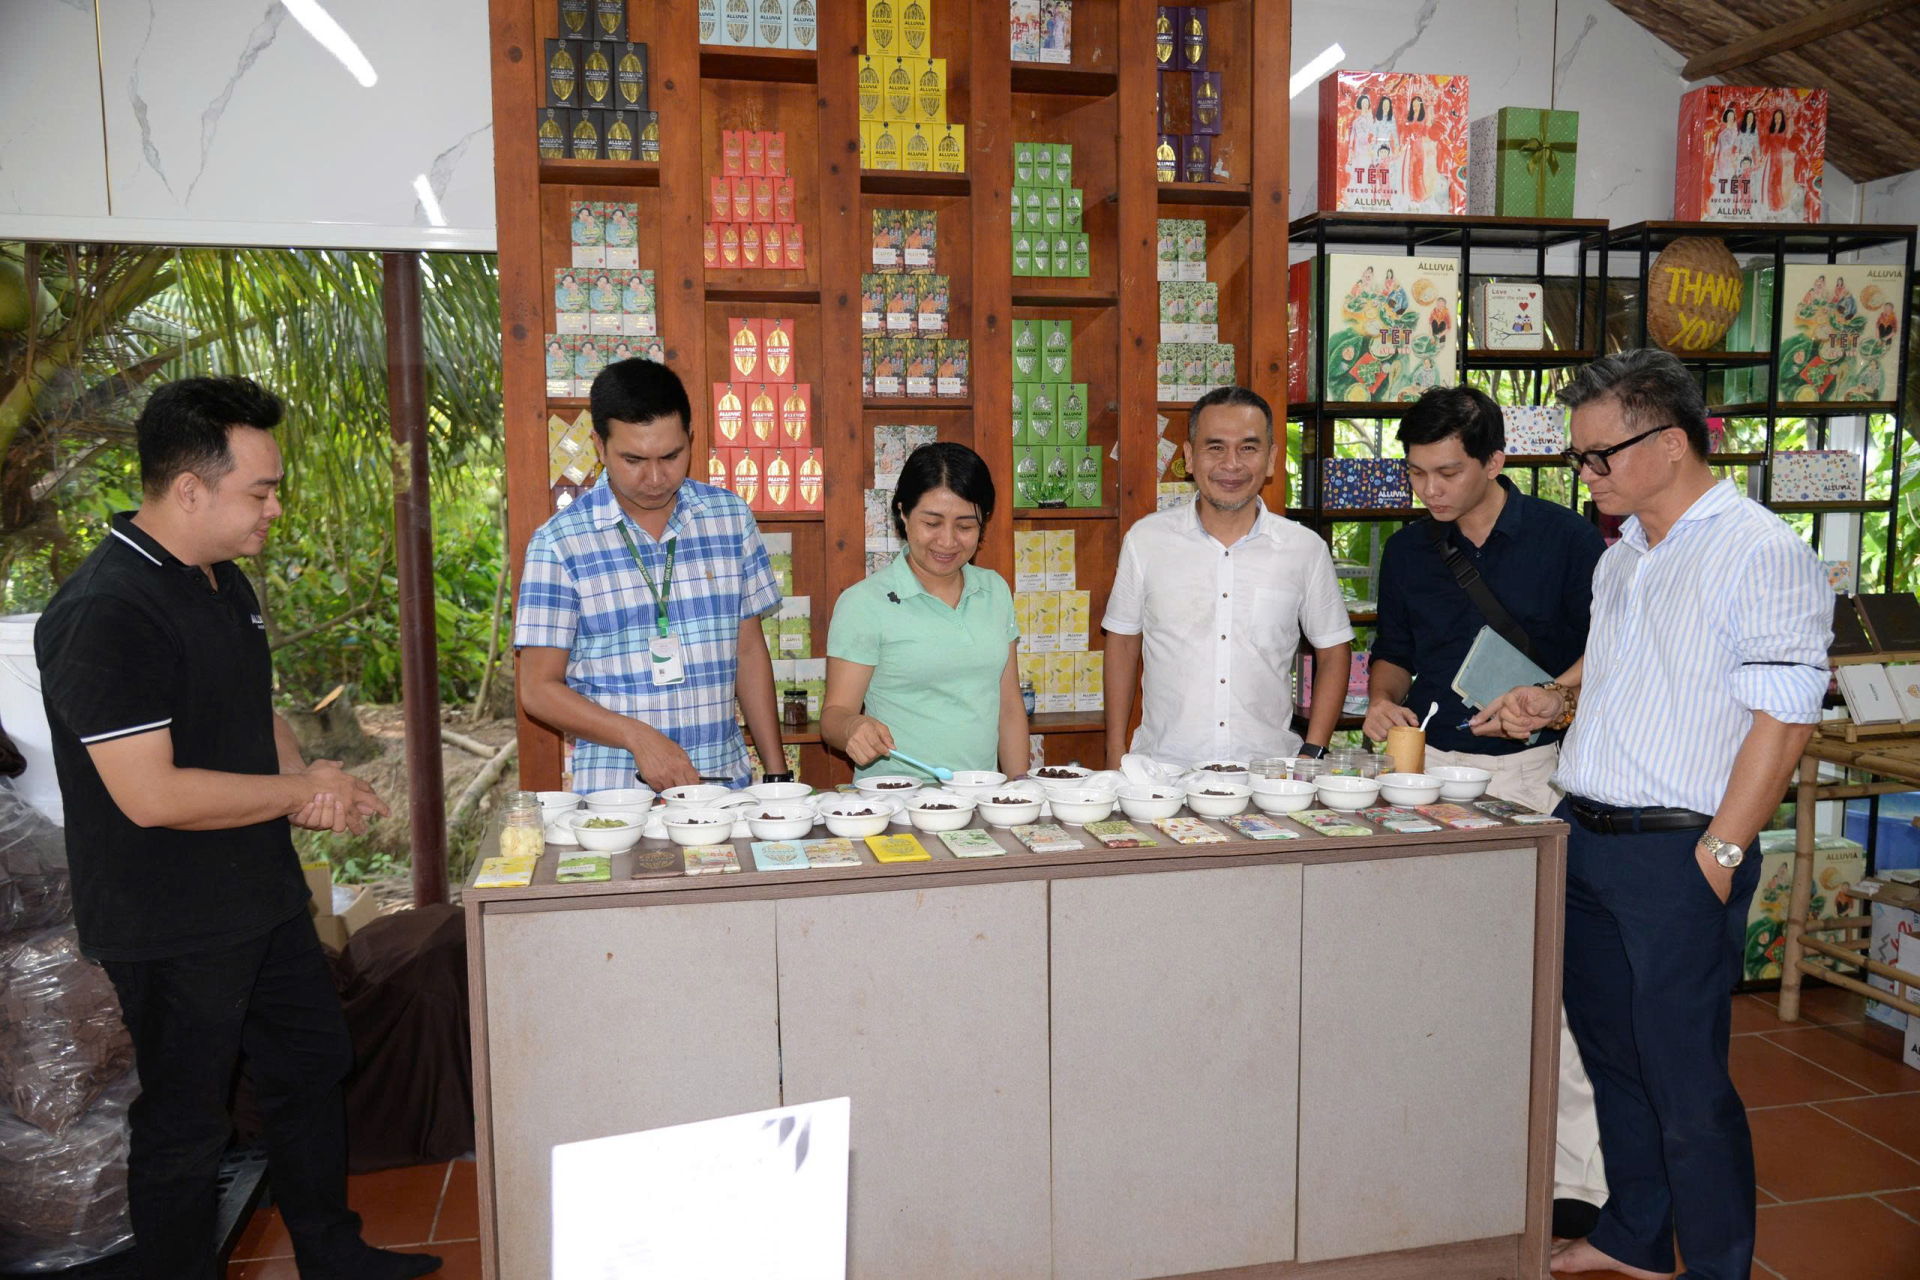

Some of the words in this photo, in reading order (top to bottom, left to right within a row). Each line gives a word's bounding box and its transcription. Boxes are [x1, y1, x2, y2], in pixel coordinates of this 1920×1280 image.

[1354, 198, 1391, 206] ALLUVIA
[1418, 262, 1455, 272] ALLUVIA
[1867, 270, 1902, 278] ALLUVIA
[1664, 266, 1744, 312] THANK
[1668, 310, 1725, 350] YOU
[1378, 490, 1406, 498] ALLUVIA
[1826, 852, 1858, 861] ALLUVIA
